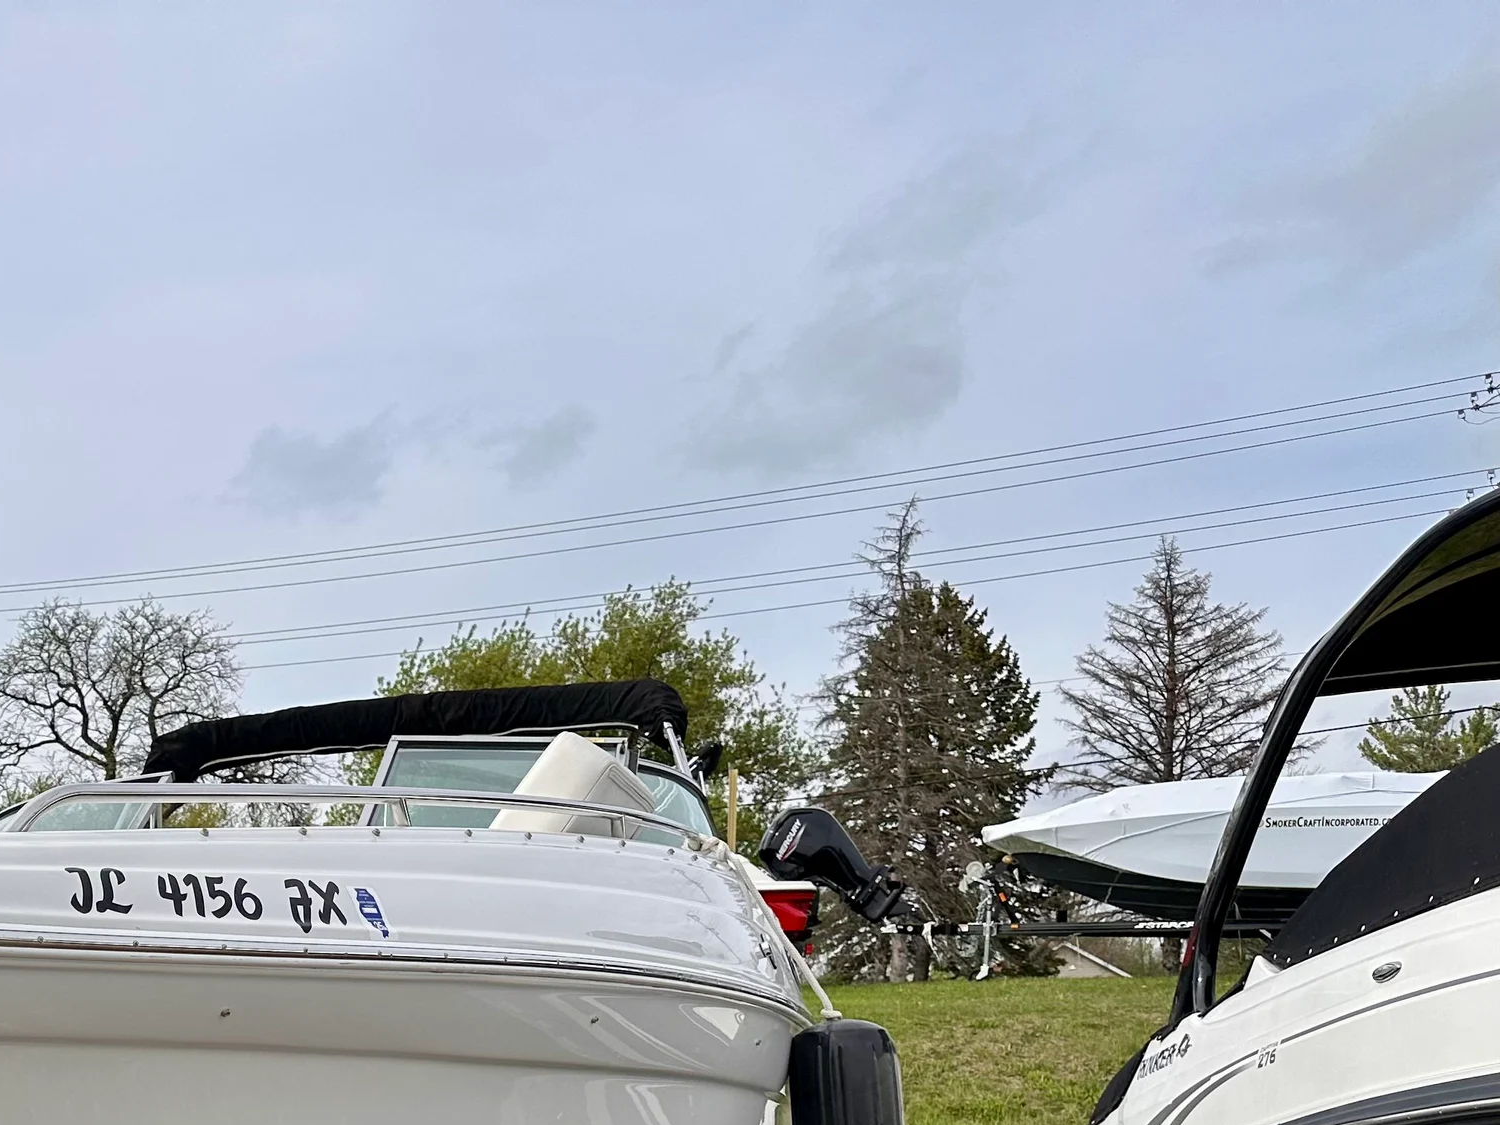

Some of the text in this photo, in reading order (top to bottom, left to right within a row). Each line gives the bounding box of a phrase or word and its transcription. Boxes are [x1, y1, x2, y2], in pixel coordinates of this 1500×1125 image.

[776, 818, 802, 860] MERCURY
[158, 873, 263, 921] 4156
[1257, 1048, 1277, 1069] 276
